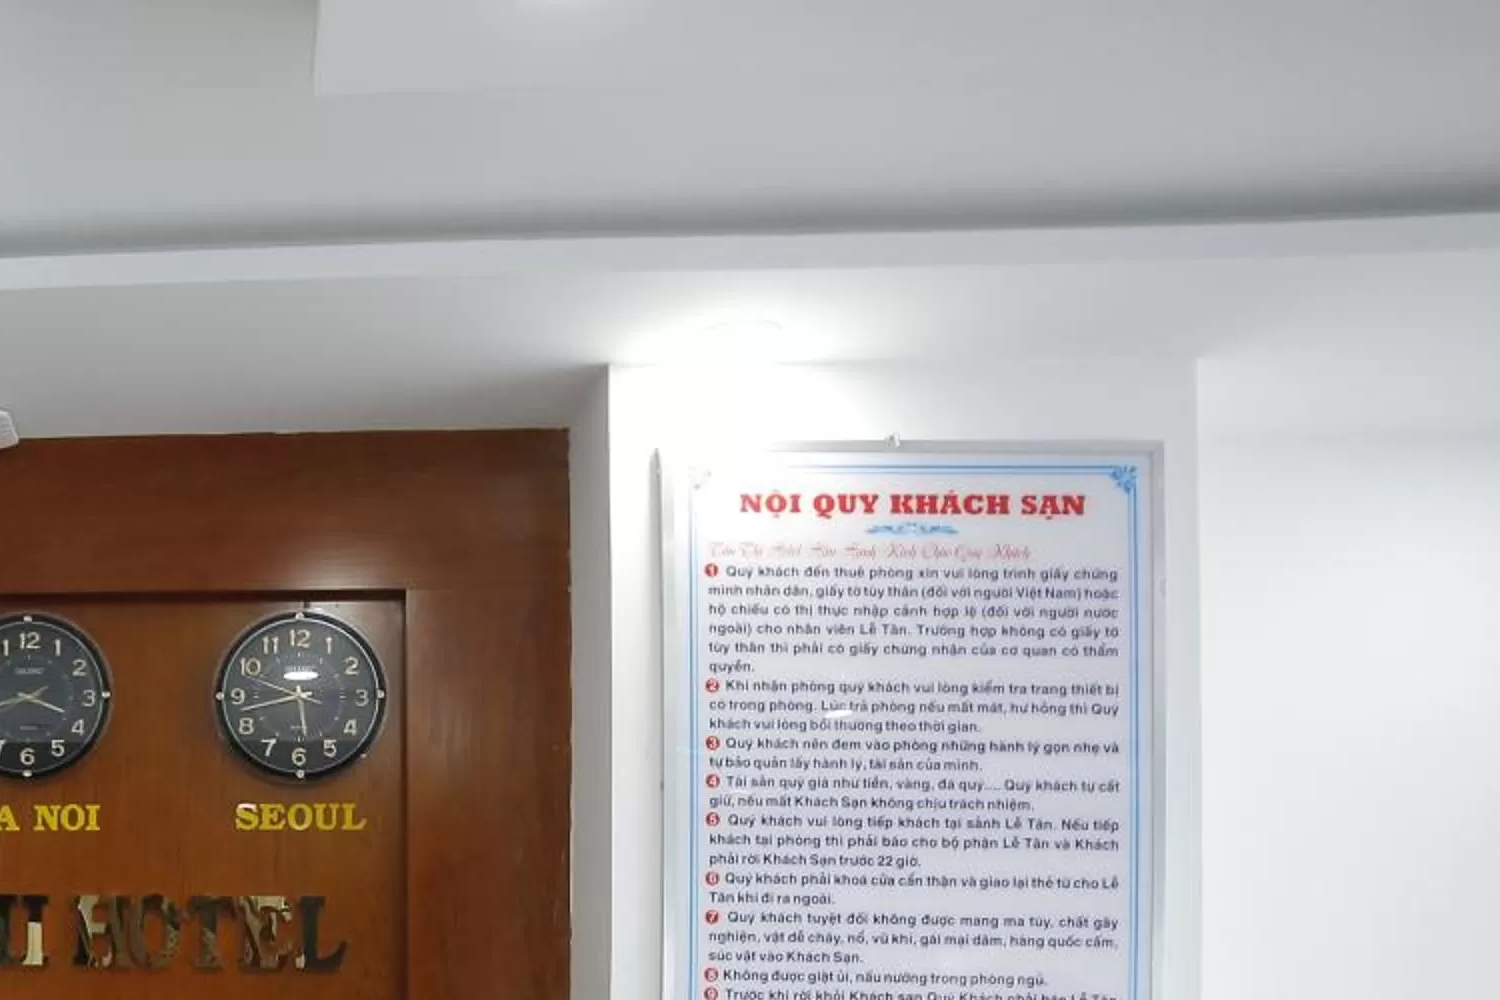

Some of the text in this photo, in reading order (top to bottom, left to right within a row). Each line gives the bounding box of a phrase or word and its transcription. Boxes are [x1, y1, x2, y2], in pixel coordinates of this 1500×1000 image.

[740, 489, 1085, 520] NỘI QUY KHÁCH SẠN
[944, 568, 964, 579] vui
[756, 623, 782, 635] cho
[19, 631, 41, 649] 12
[262, 636, 279, 654] 11
[289, 629, 312, 648] 12
[325, 636, 333, 654] 1
[55, 639, 61, 657] 1
[72, 659, 87, 676] 2
[239, 657, 261, 676] 10
[344, 657, 360, 675] 2
[725, 679, 749, 690] Khi
[914, 681, 935, 693] vui
[81, 689, 96, 707] 3
[230, 688, 246, 705] 9
[355, 689, 369, 707] 3
[729, 699, 765, 714] trong
[71, 719, 85, 736] 4
[238, 717, 254, 735] 8
[343, 719, 357, 736] 4
[754, 718, 775, 730] vui
[885, 720, 917, 731] theo
[20, 747, 35, 765] 6
[51, 739, 65, 757] 5
[260, 738, 277, 757] 7
[323, 739, 337, 758] 5
[291, 748, 307, 766] 6
[33, 804, 100, 831] NOI
[235, 803, 367, 831] SEOUL
[807, 815, 828, 827] vui
[911, 836, 938, 848] cho
[877, 856, 893, 867] 22
[979, 876, 1010, 890] giao
[1073, 877, 1099, 889] cho
[777, 896, 790, 904] ra
[71, 894, 348, 971] HOTEL
[960, 918, 999, 929] mang
[1003, 918, 1025, 927] ma
[769, 990, 789, 1000] khi
